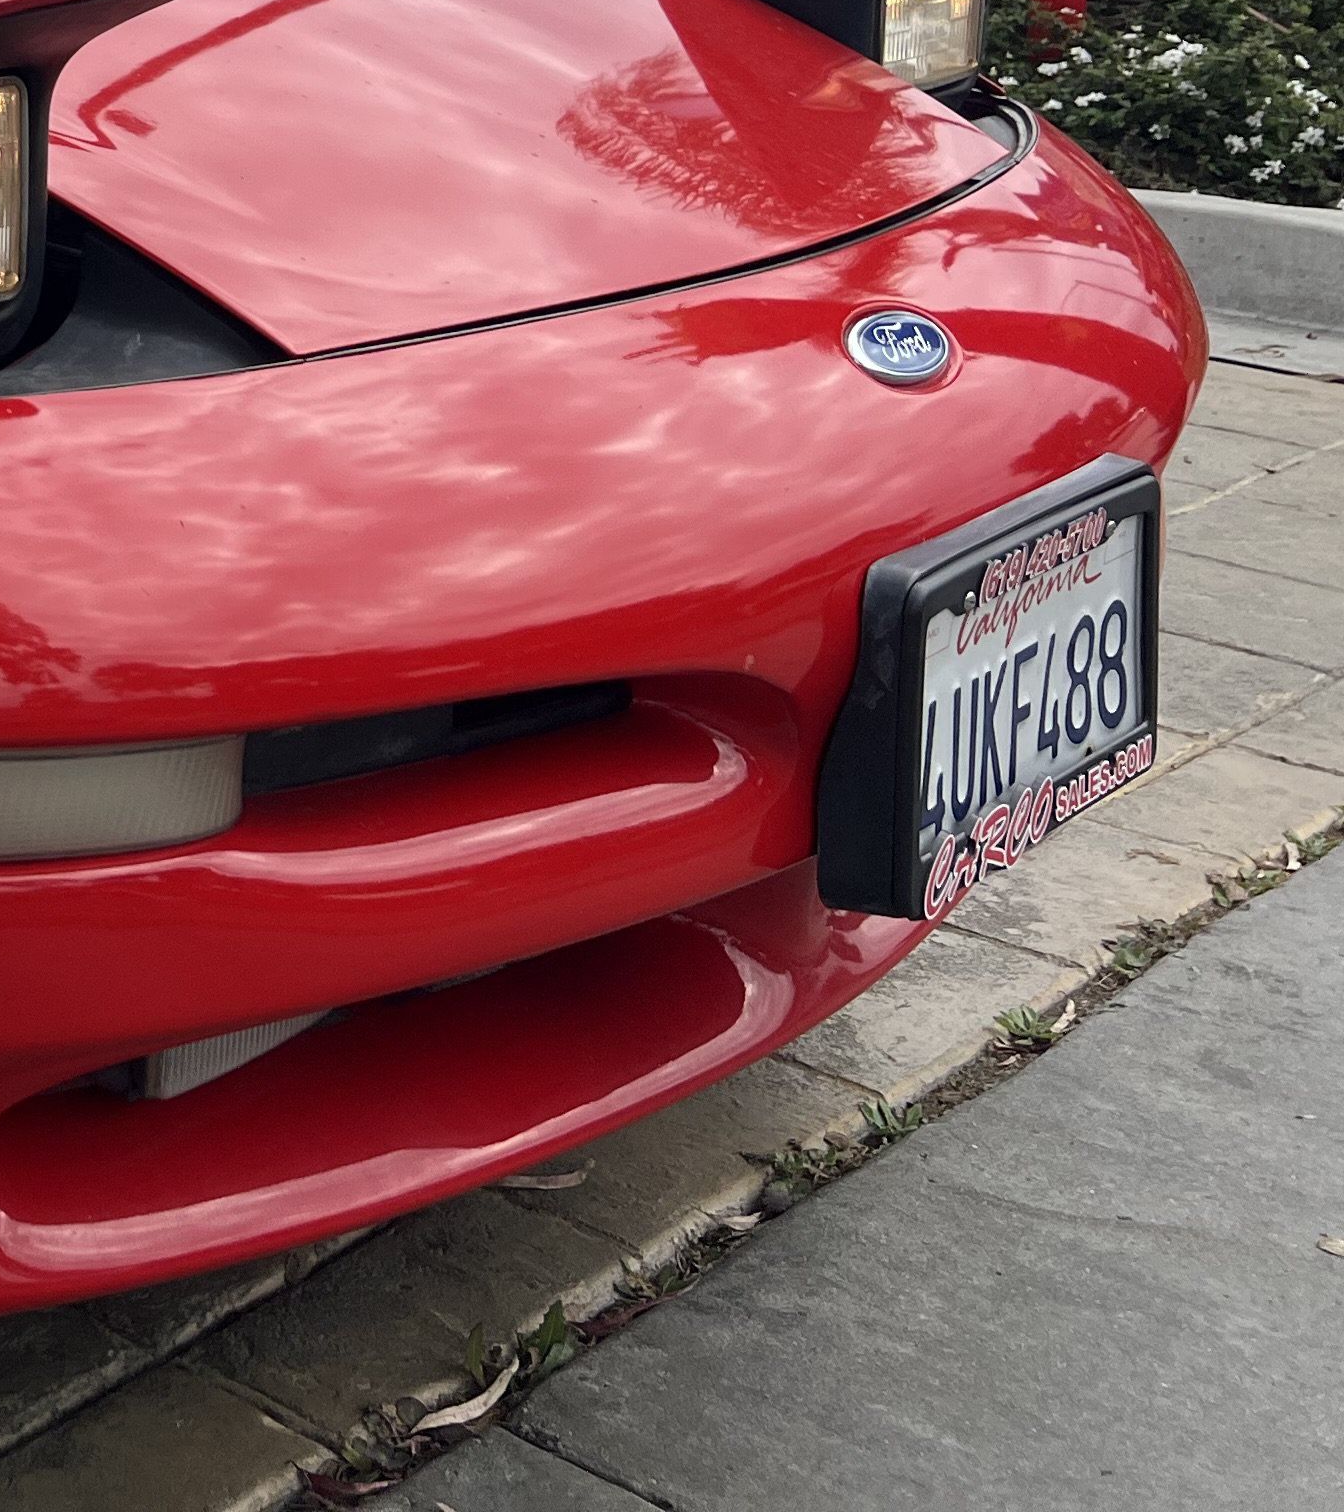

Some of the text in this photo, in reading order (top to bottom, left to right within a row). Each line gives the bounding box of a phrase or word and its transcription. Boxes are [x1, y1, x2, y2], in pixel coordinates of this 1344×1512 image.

[872, 321, 933, 364] Ford
[956, 554, 1102, 656] California
[979, 506, 1108, 608] (619) 420-5700
[918, 599, 1128, 836] 4UKF488
[924, 733, 1153, 920] CARCO SALES.COM
